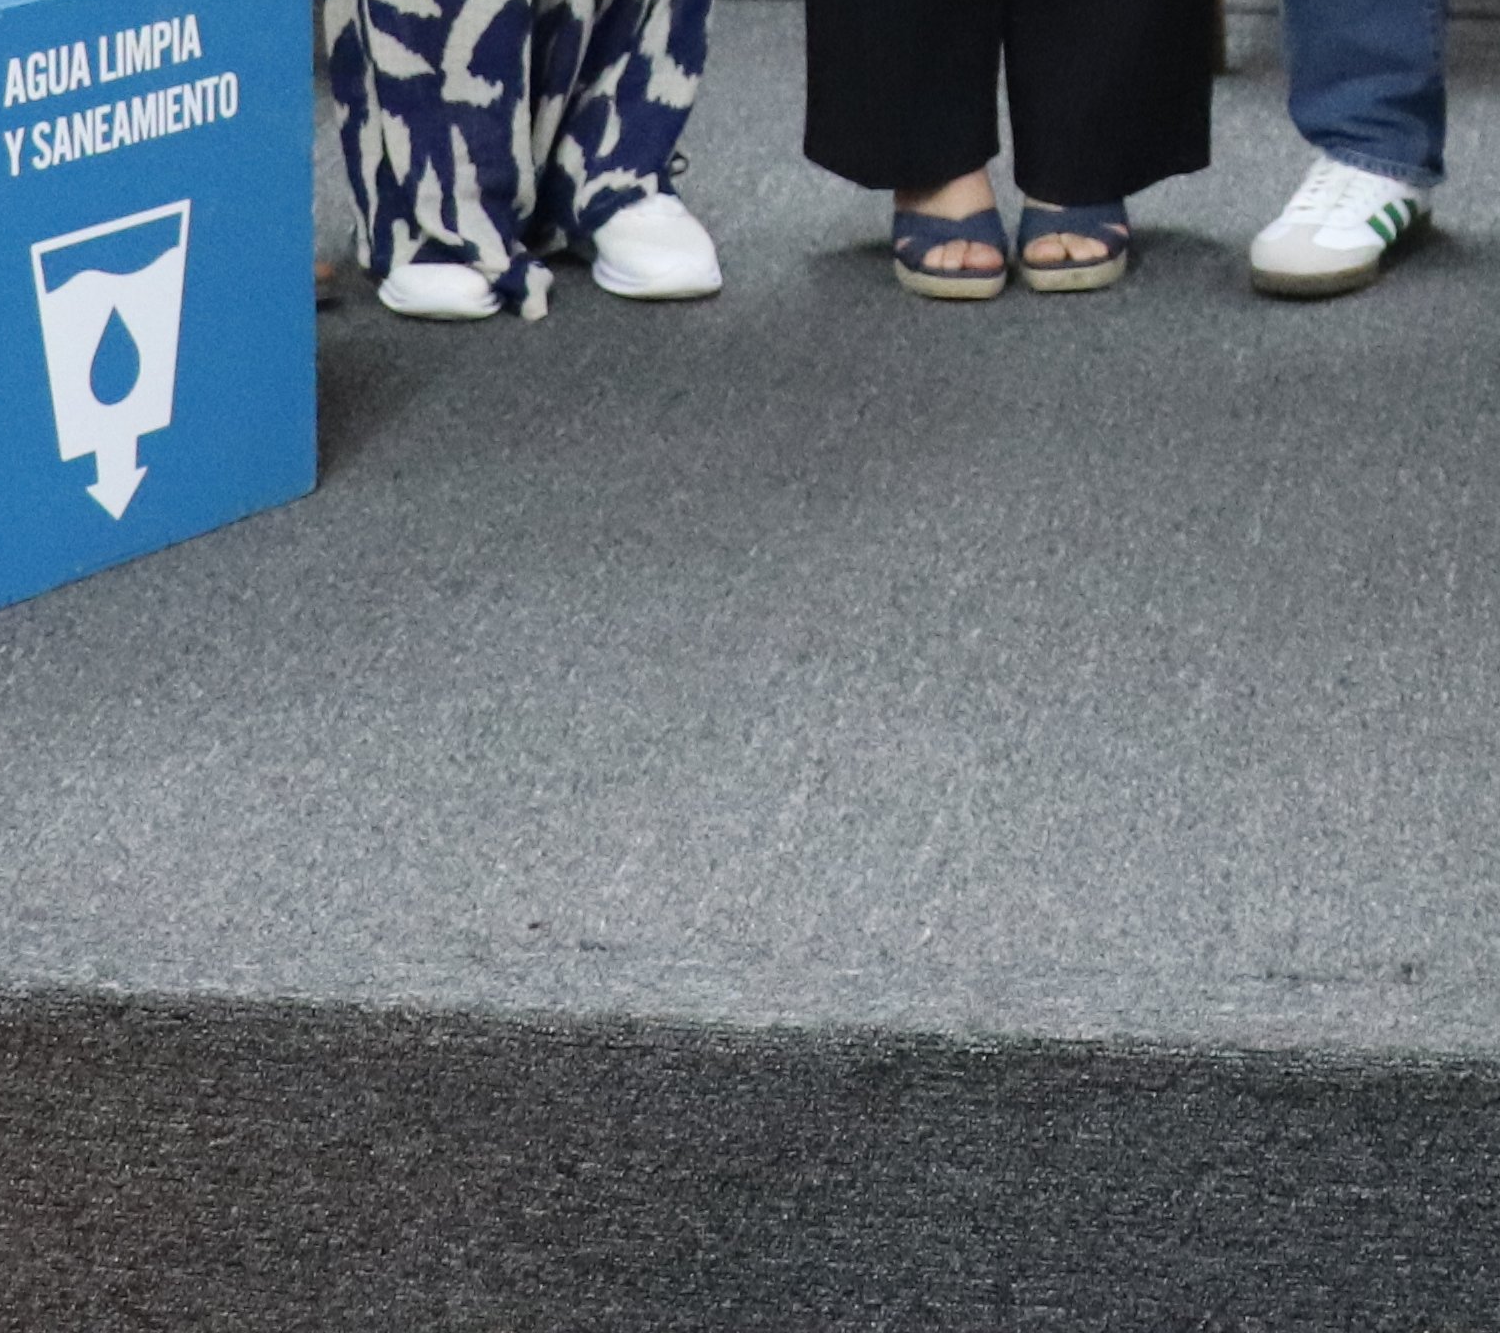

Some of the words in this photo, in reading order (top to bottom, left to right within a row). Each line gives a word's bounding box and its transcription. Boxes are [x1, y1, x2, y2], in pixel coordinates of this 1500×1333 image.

[5, 42, 90, 107] AGUA
[100, 15, 201, 82] LIMPIA
[5, 128, 24, 175] Y
[33, 73, 237, 169] SANEAMIENTO
